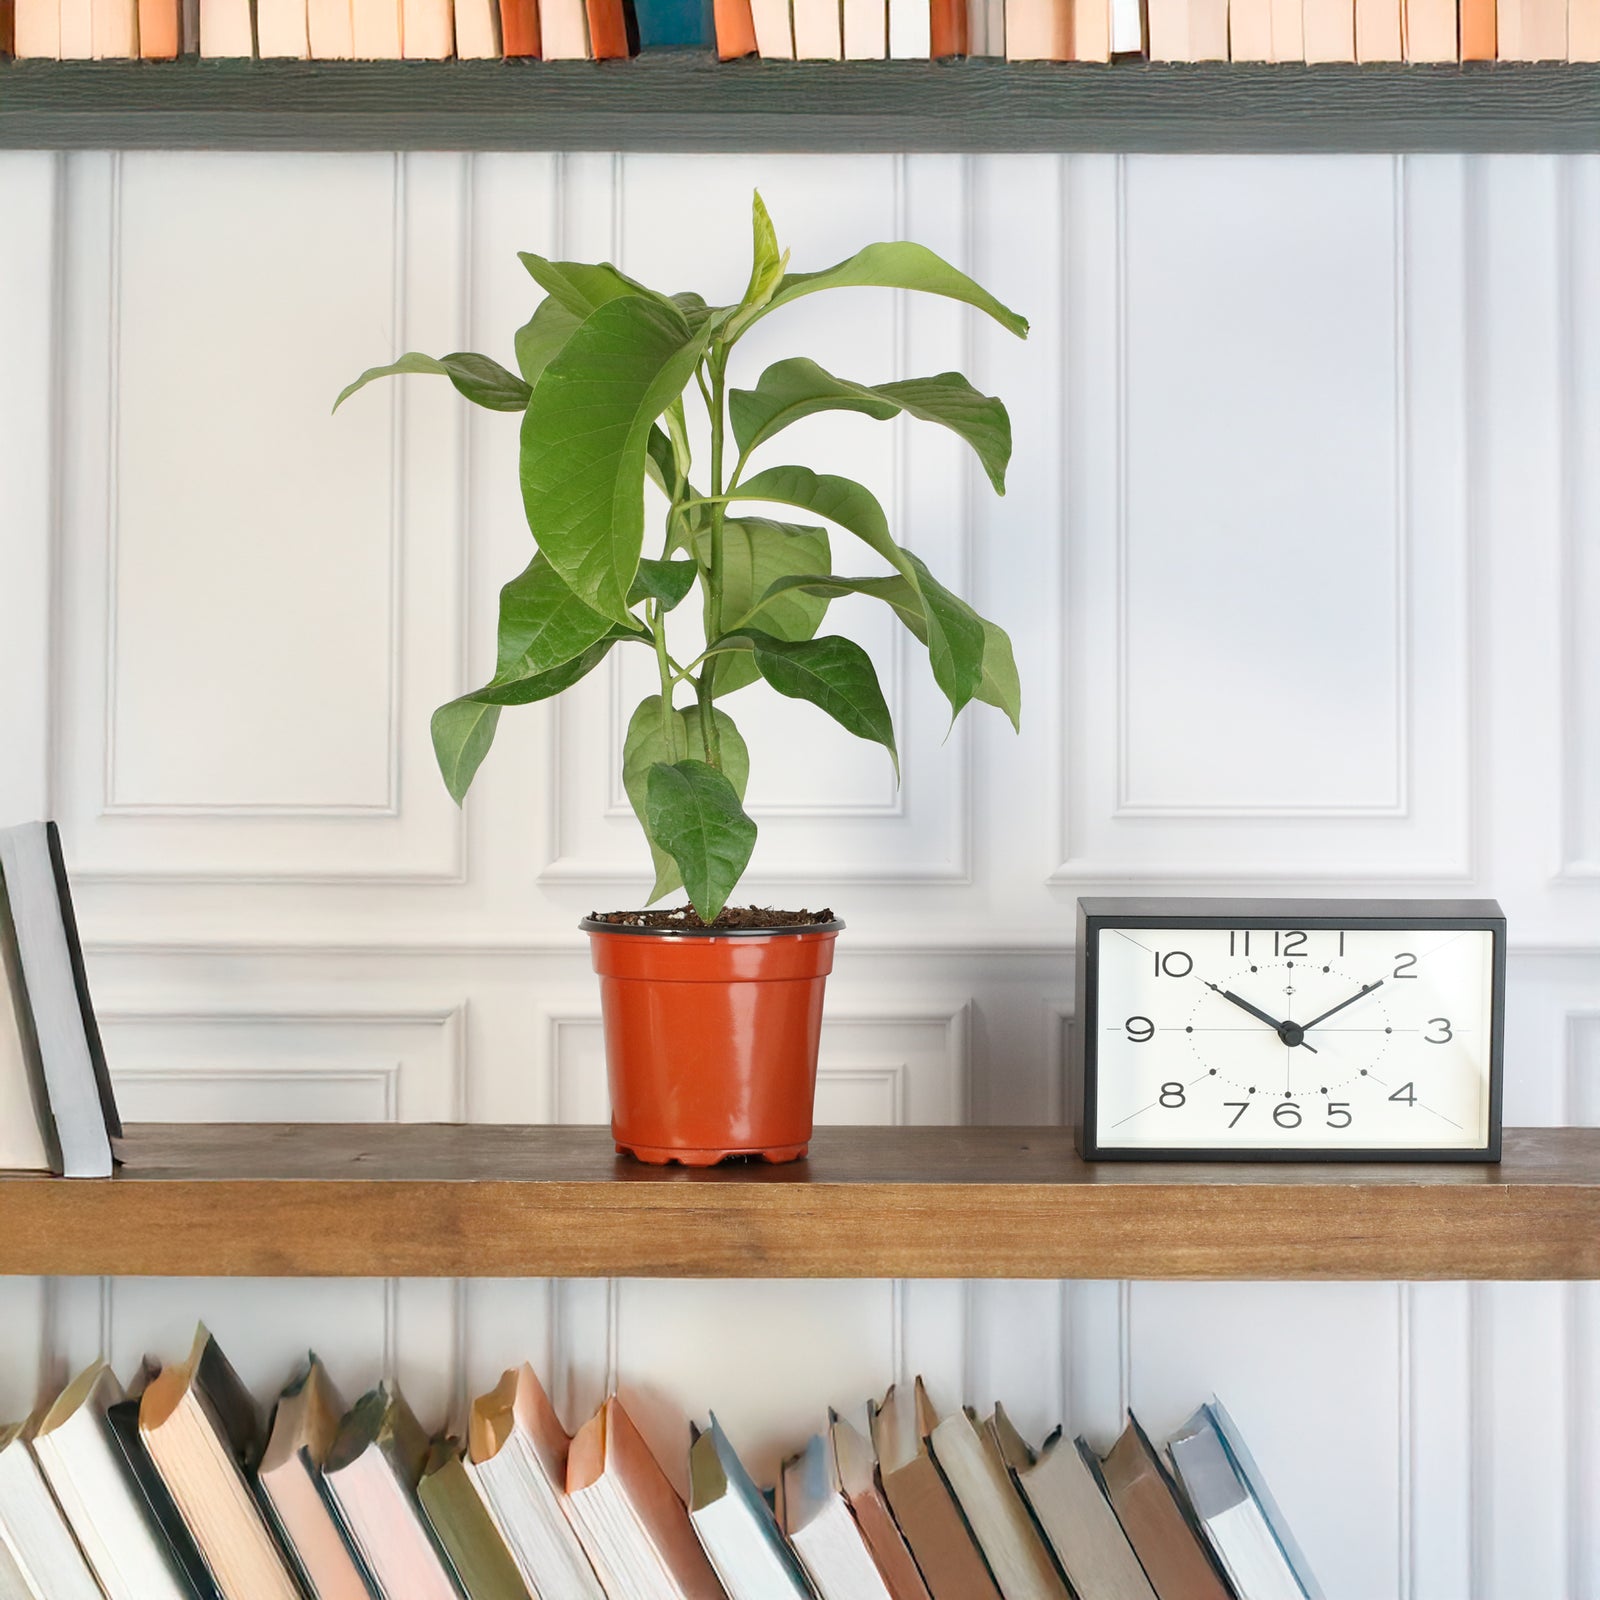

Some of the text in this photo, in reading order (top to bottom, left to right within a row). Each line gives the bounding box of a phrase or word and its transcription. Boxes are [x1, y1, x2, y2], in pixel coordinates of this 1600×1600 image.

[1230, 931, 1250, 957] 11
[1274, 930, 1308, 957] 12
[1339, 931, 1345, 957] 1
[1154, 951, 1194, 978] 10
[1394, 952, 1418, 979] 2
[1125, 1015, 1155, 1043] 9
[1424, 1017, 1453, 1044] 3
[1158, 1081, 1186, 1109] 8
[1388, 1081, 1418, 1107] 4
[1223, 1102, 1250, 1129] 7
[1272, 1102, 1302, 1129] 6
[1326, 1102, 1352, 1129] 5
